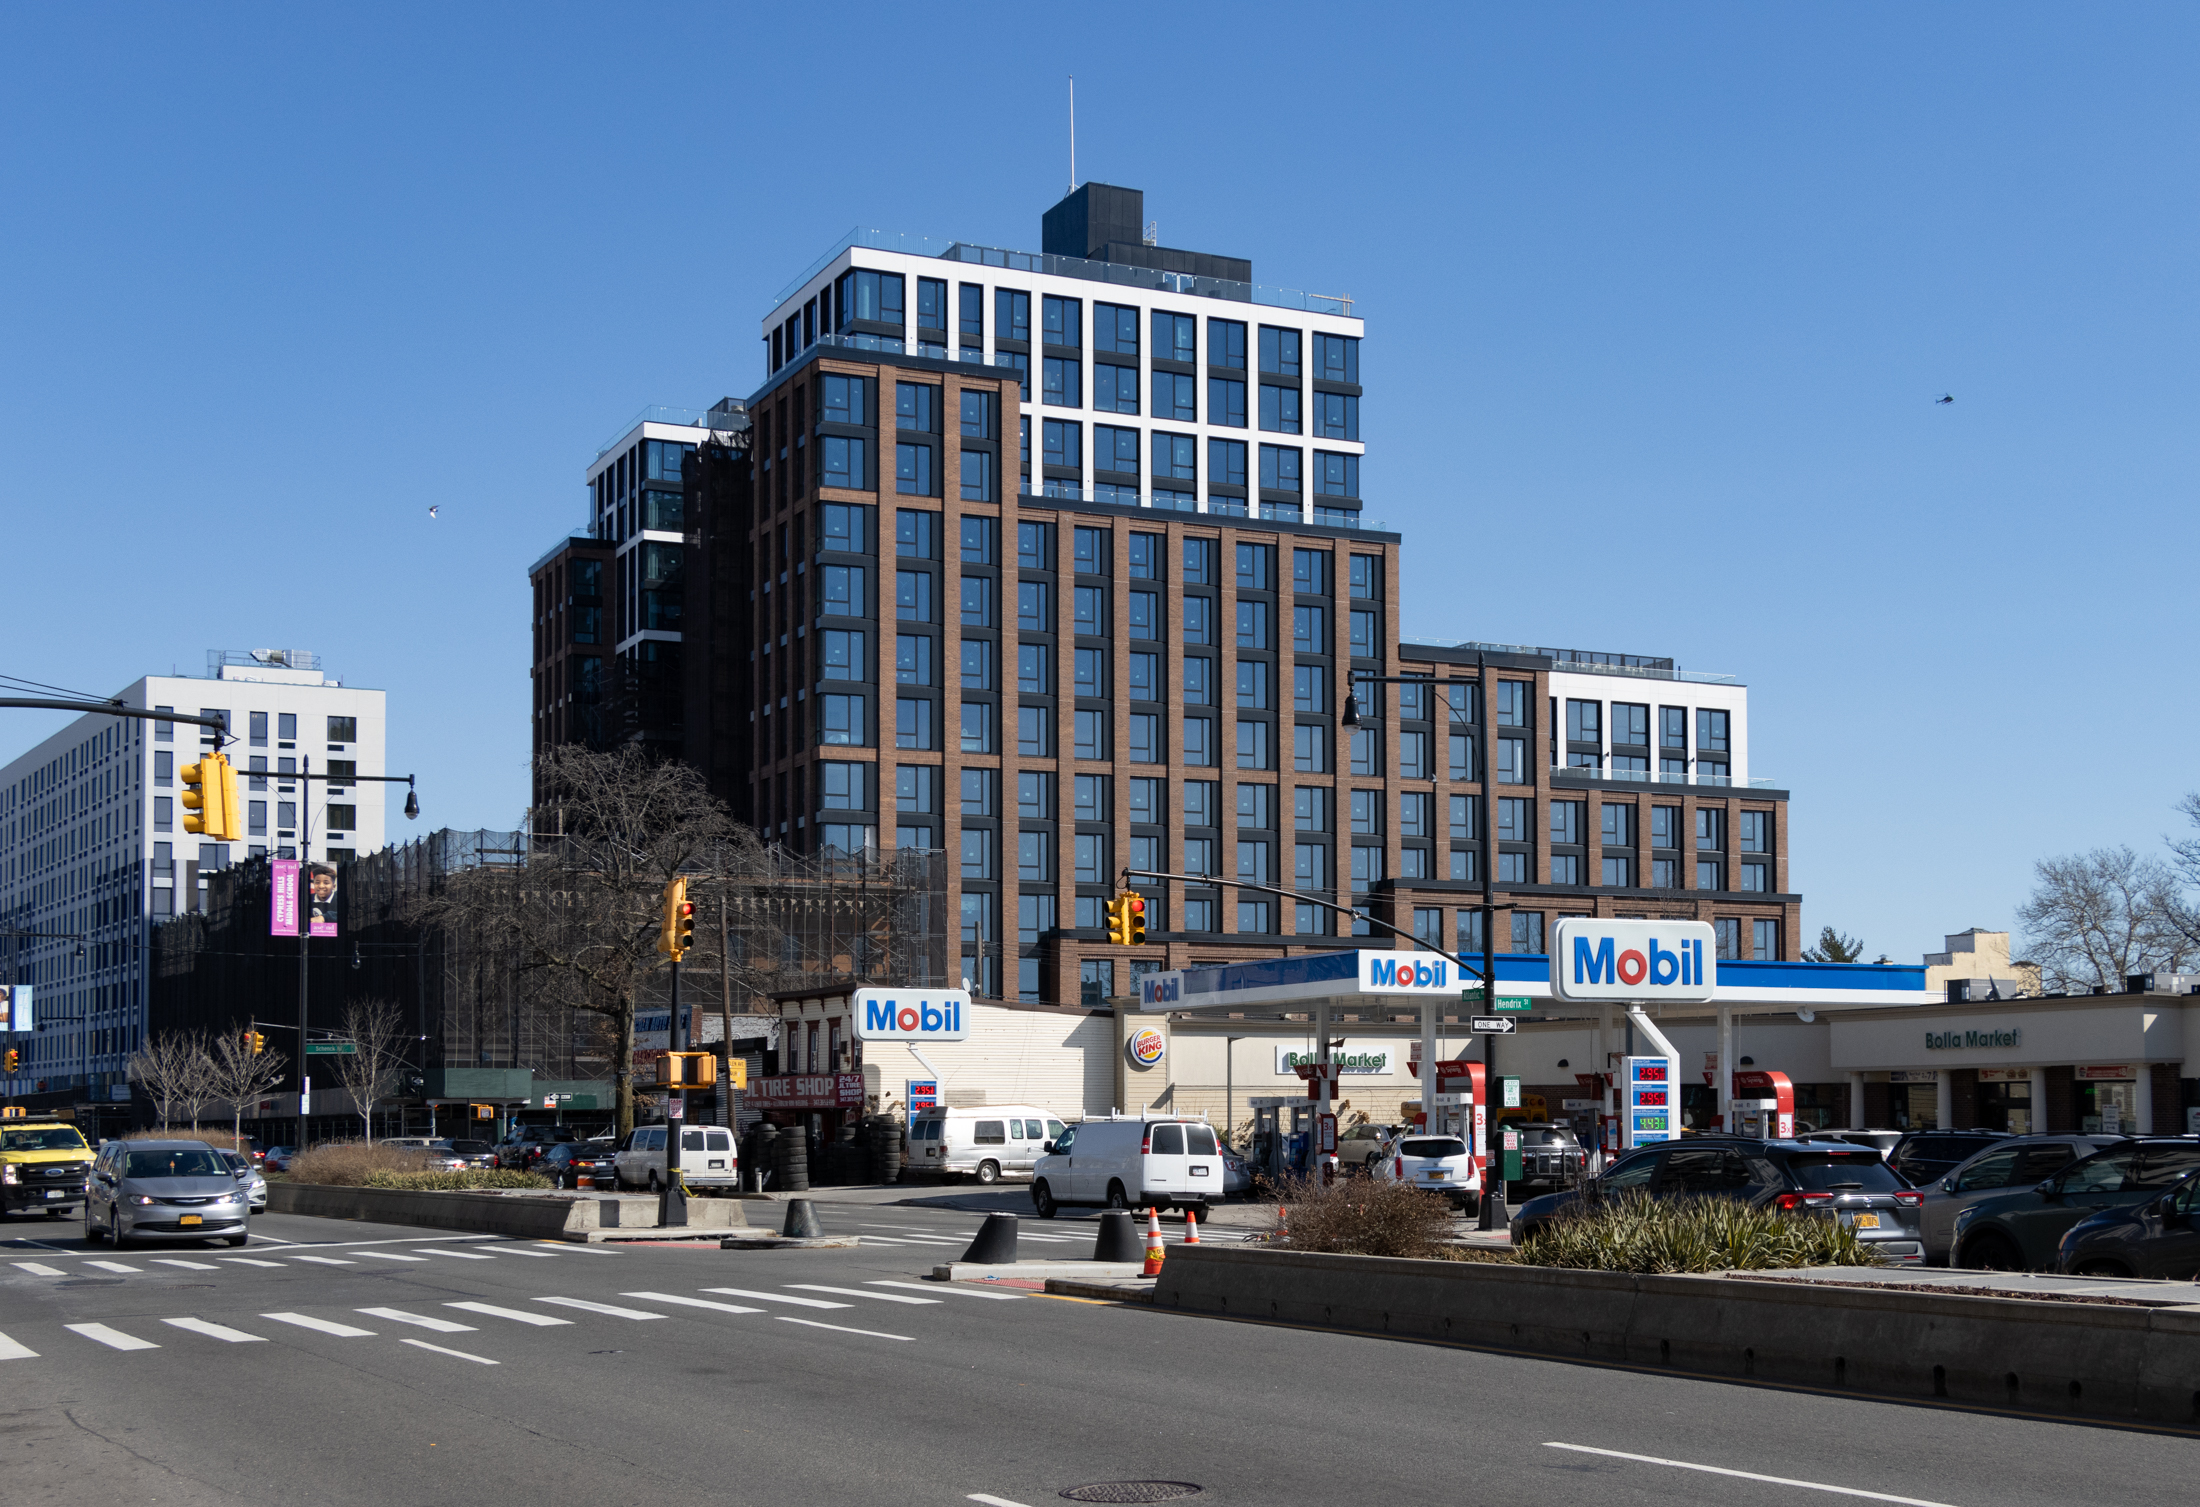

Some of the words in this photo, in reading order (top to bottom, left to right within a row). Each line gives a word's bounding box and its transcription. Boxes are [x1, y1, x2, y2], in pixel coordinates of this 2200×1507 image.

[276, 876, 285, 893] HILLS
[286, 873, 294, 899] SCHOOL
[276, 894, 285, 923] CYPRESS
[285, 900, 294, 926] MIDDLE
[1574, 936, 1703, 986] Mobil
[1371, 958, 1446, 988] Mobil
[1144, 977, 1180, 1004] Mobil
[1463, 990, 1480, 1000] Atlantic
[1497, 998, 1522, 1009] Hendrix
[1523, 998, 1529, 1006] St
[866, 999, 960, 1032] Mobil
[1477, 1021, 1491, 1029] ONE
[1495, 1021, 1509, 1029] WAY
[1136, 1034, 1161, 1048] BURGER
[1926, 1031, 1962, 1049] Bolla
[1965, 1028, 2018, 1048] Market
[1137, 1040, 1162, 1057] KING
[1289, 1052, 1318, 1067] Boll
[1333, 1052, 1387, 1067] Market
[744, 1080, 759, 1098] JL
[760, 1078, 791, 1097] TIRE
[795, 1077, 835, 1096] SHOP
[838, 1075, 860, 1083] 24/7
[839, 1088, 862, 1097] SHOP
[1324, 1122, 1333, 1131] 3x
[1780, 1122, 1791, 1133] 3x
